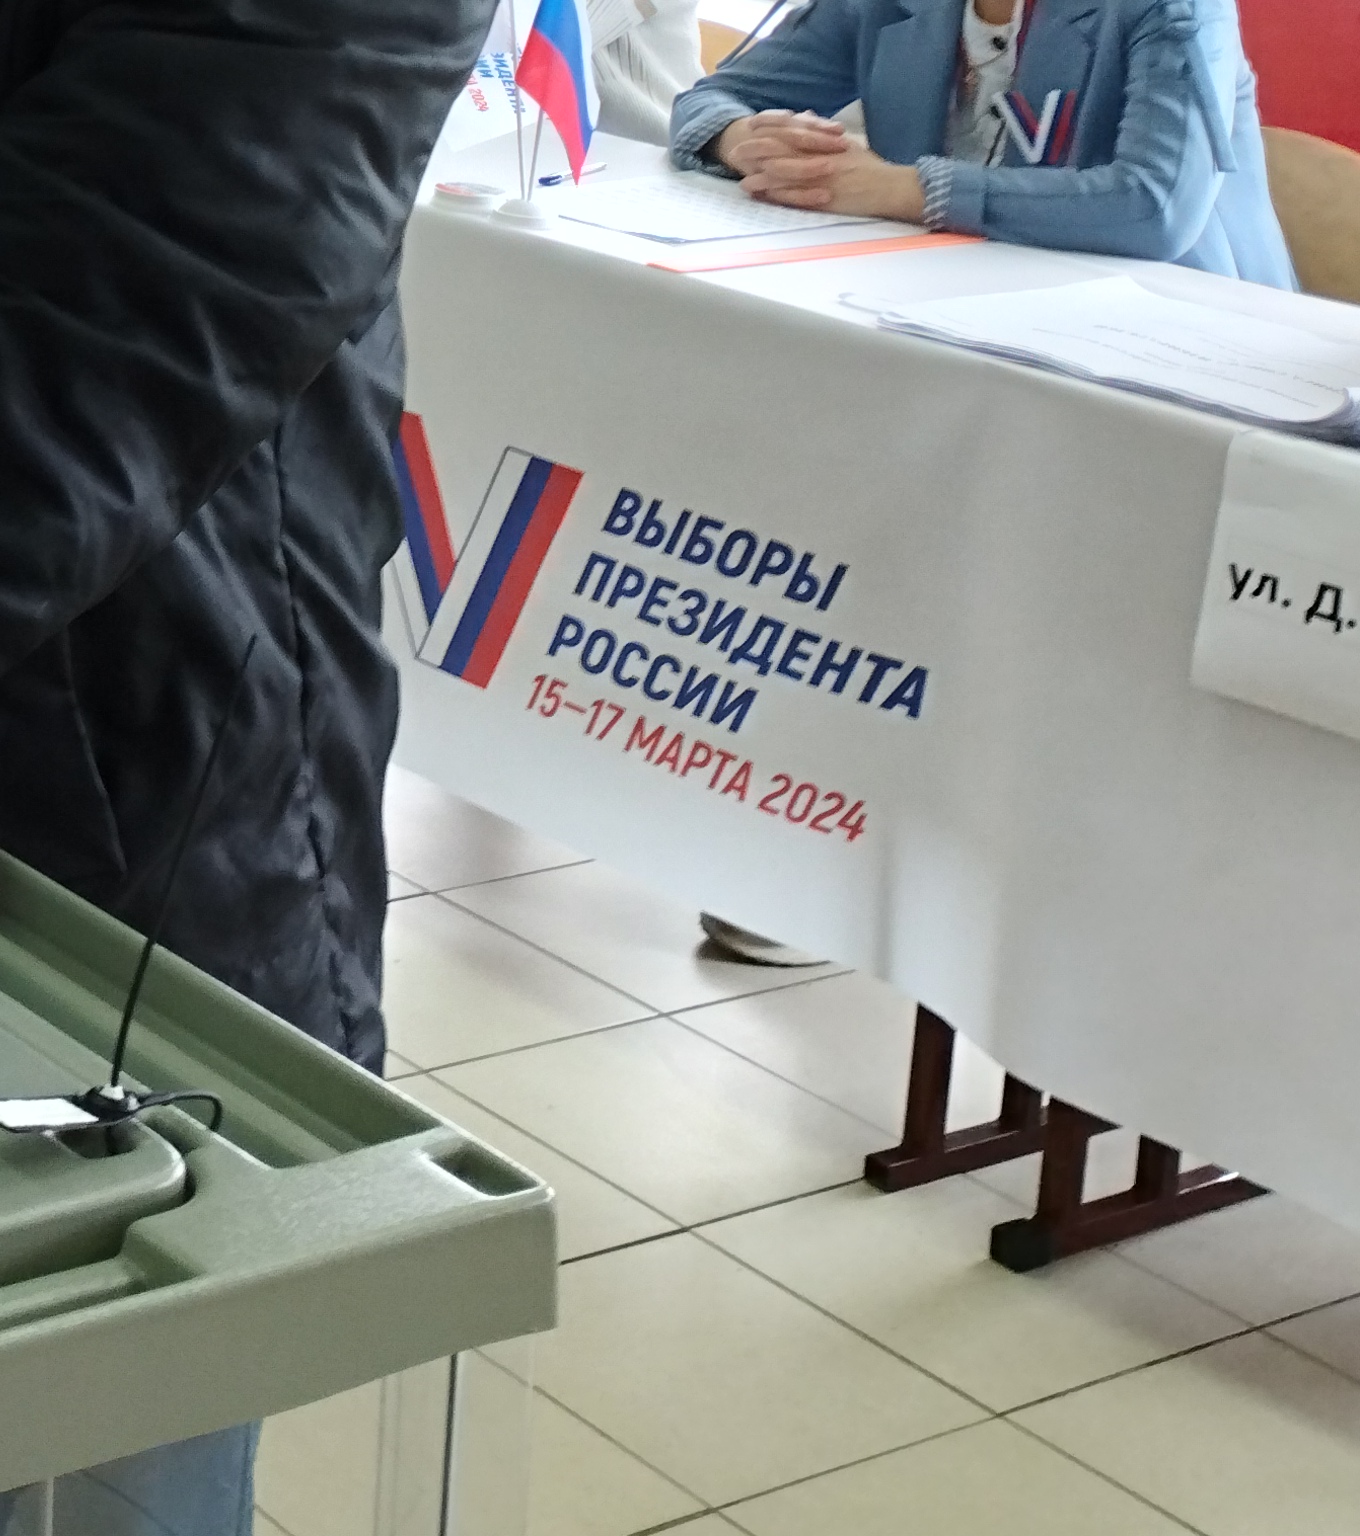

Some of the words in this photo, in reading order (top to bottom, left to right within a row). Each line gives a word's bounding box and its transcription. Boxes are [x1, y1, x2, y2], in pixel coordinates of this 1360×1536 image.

[601, 486, 848, 612] ВЫБОРЫ
[1229, 562, 1291, 607] ул.
[546, 613, 760, 734] РОССИИ
[573, 550, 930, 720] ПРЕЗИДЕНТА
[625, 714, 755, 803] МАРТА
[757, 772, 869, 843] 2024
